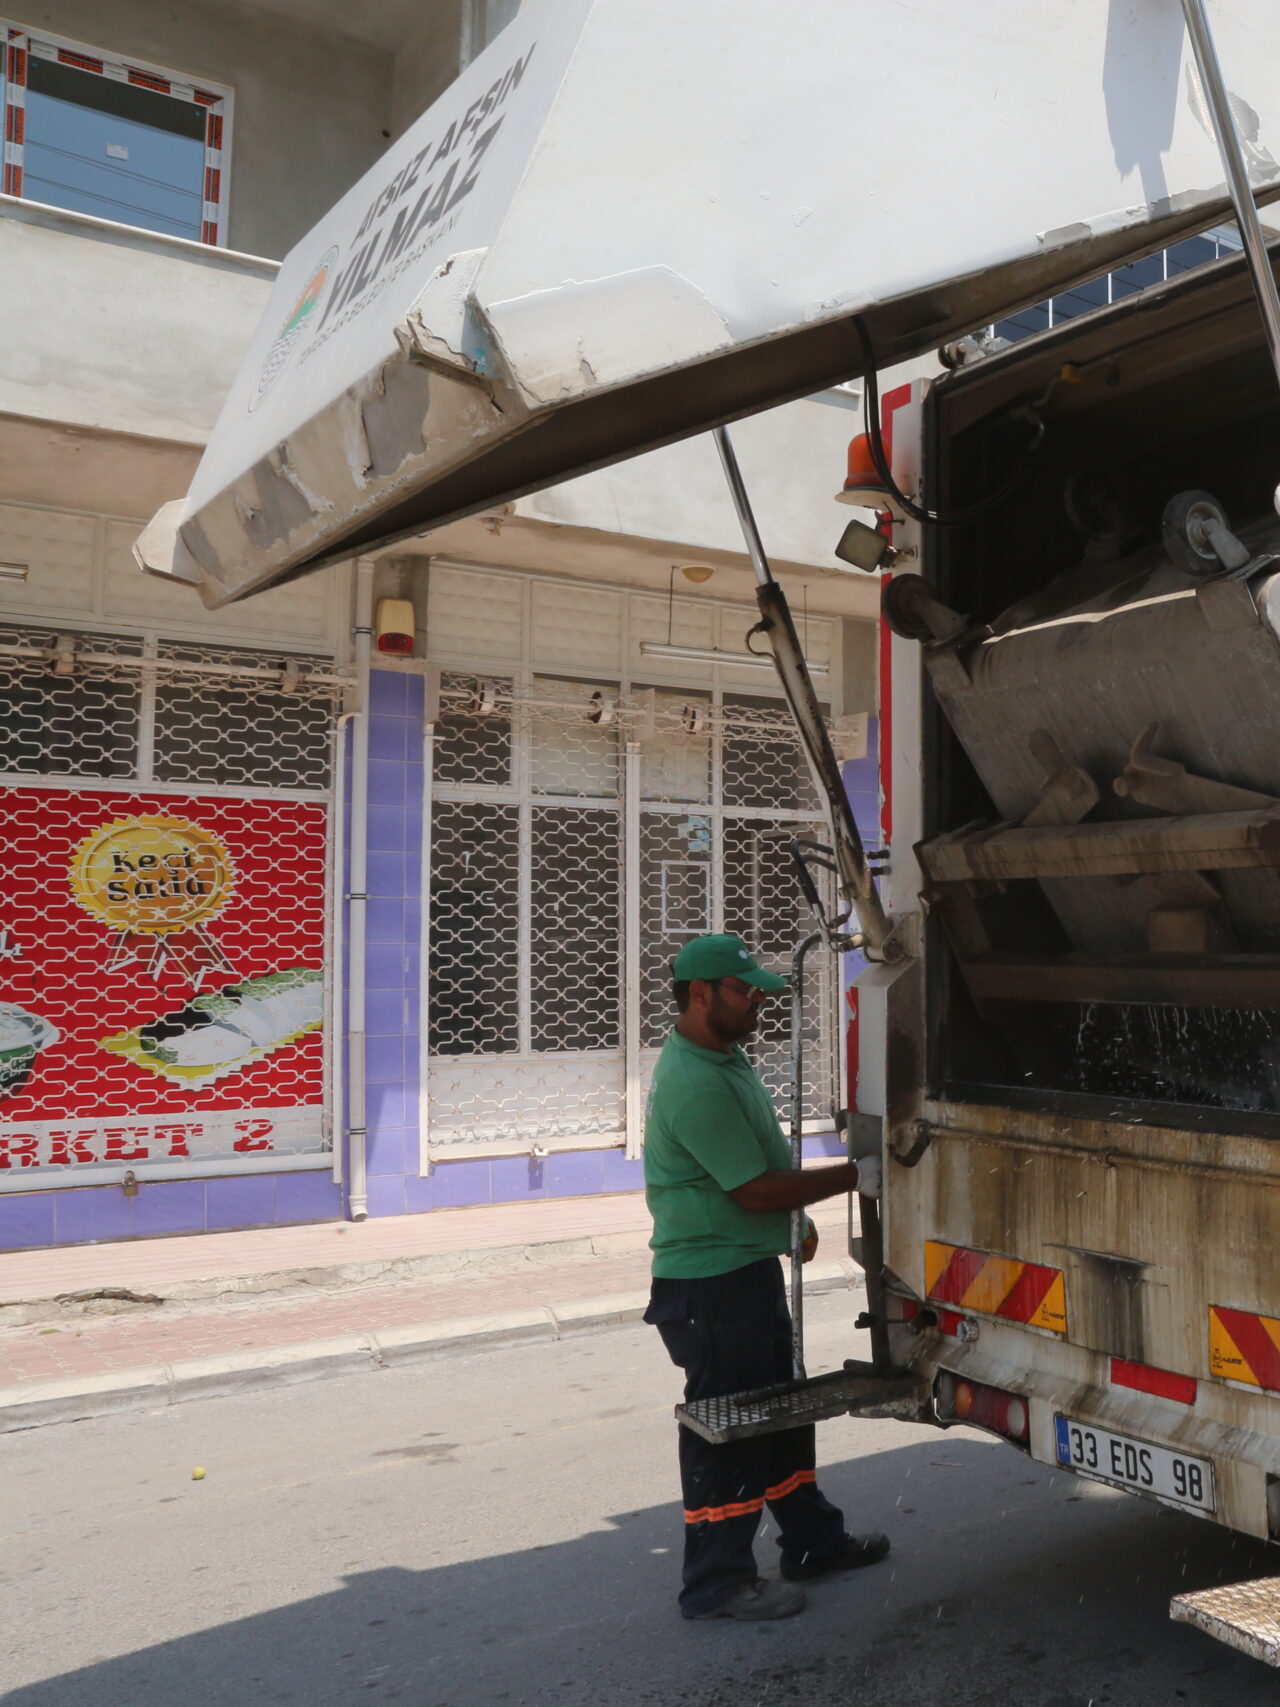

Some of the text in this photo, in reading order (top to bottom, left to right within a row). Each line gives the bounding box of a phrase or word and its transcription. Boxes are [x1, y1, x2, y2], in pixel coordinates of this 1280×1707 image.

[425, 41, 537, 174] AFŞIN
[315, 113, 506, 334] YILMAZ
[233, 1119, 274, 1152] 2
[1070, 1428, 1204, 1501] 33 EDS 98
